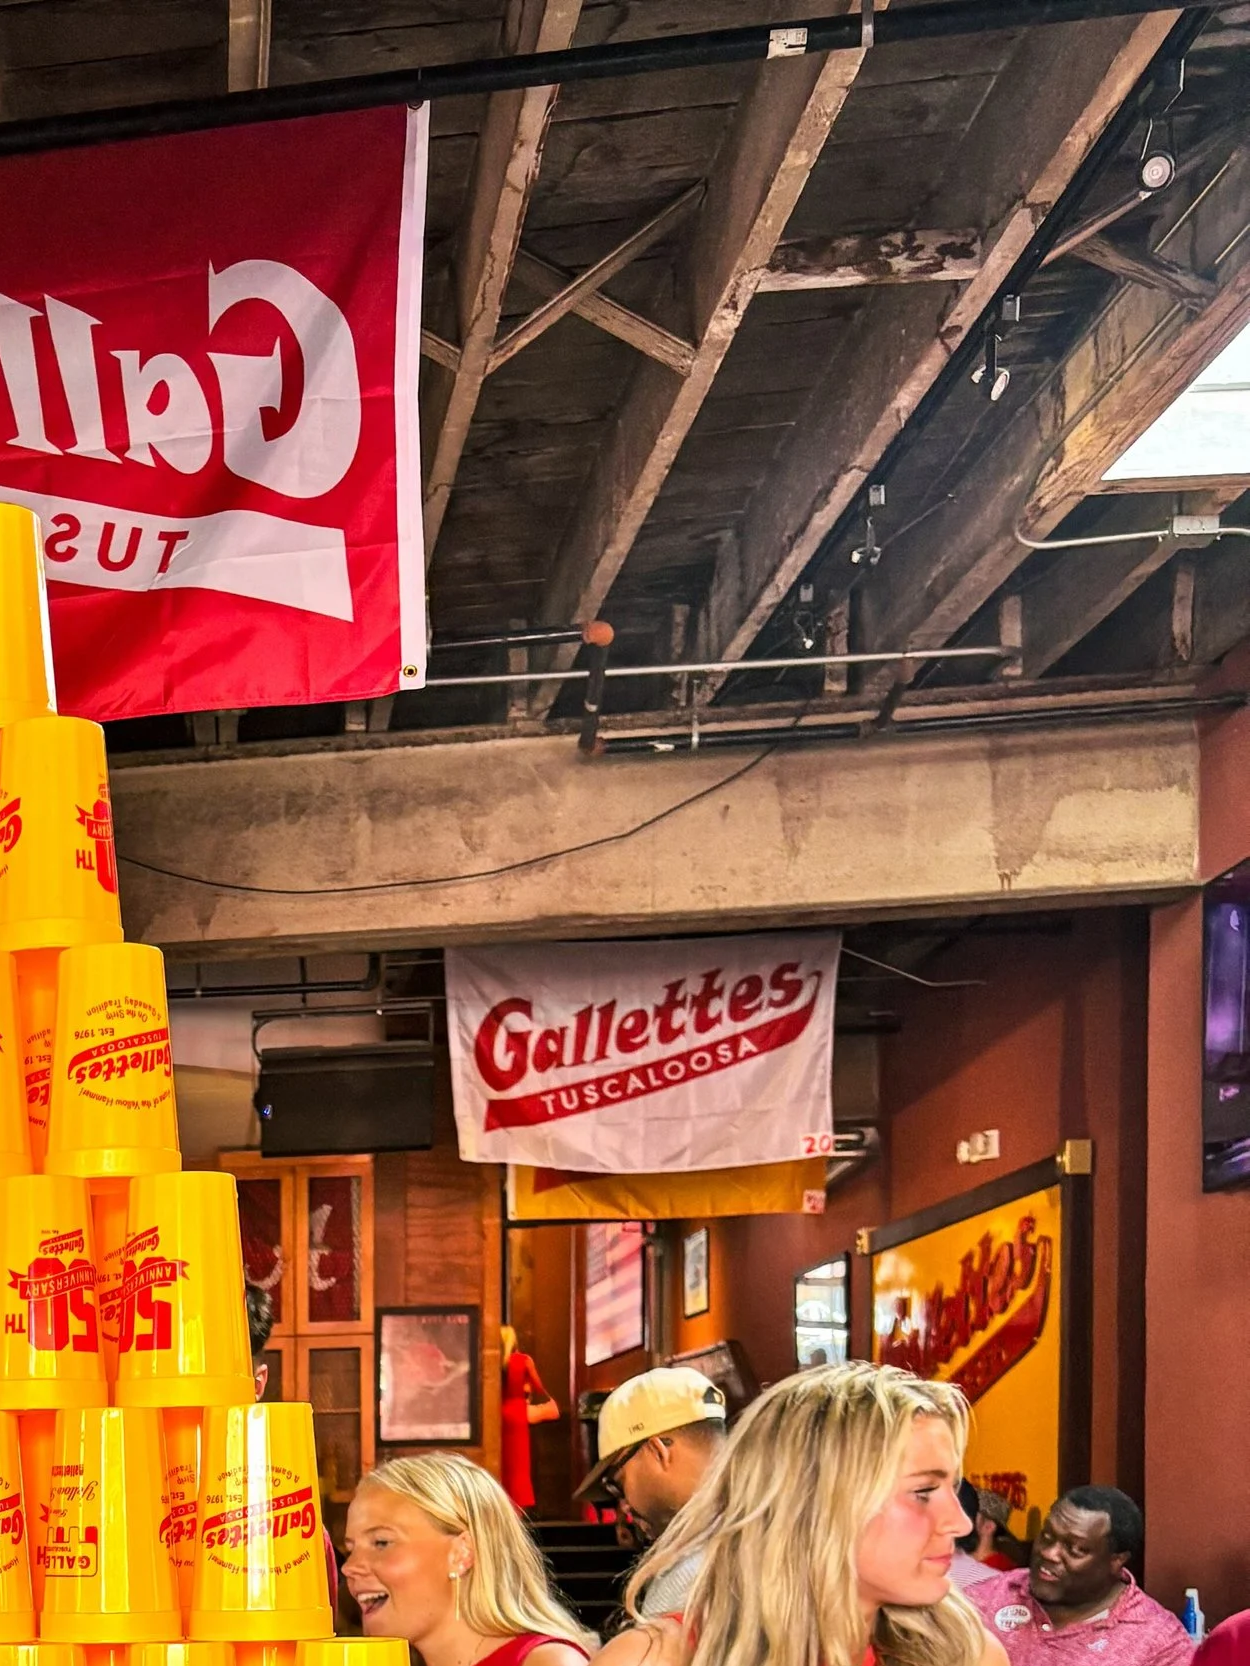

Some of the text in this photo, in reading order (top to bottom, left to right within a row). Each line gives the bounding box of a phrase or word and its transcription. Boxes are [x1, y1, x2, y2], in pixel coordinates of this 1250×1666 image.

[74, 1028, 114, 1040] Est. 1976
[91, 1031, 162, 1056] TUSCALOOSA
[475, 961, 803, 1092] Gallettes
[540, 1035, 759, 1116] TUSCALOOSA
[802, 1135, 832, 1155] 20
[5, 1258, 97, 1352] 50 TH
[206, 1495, 242, 1504] Est. 1976
[206, 1504, 316, 1551] Gallettes
